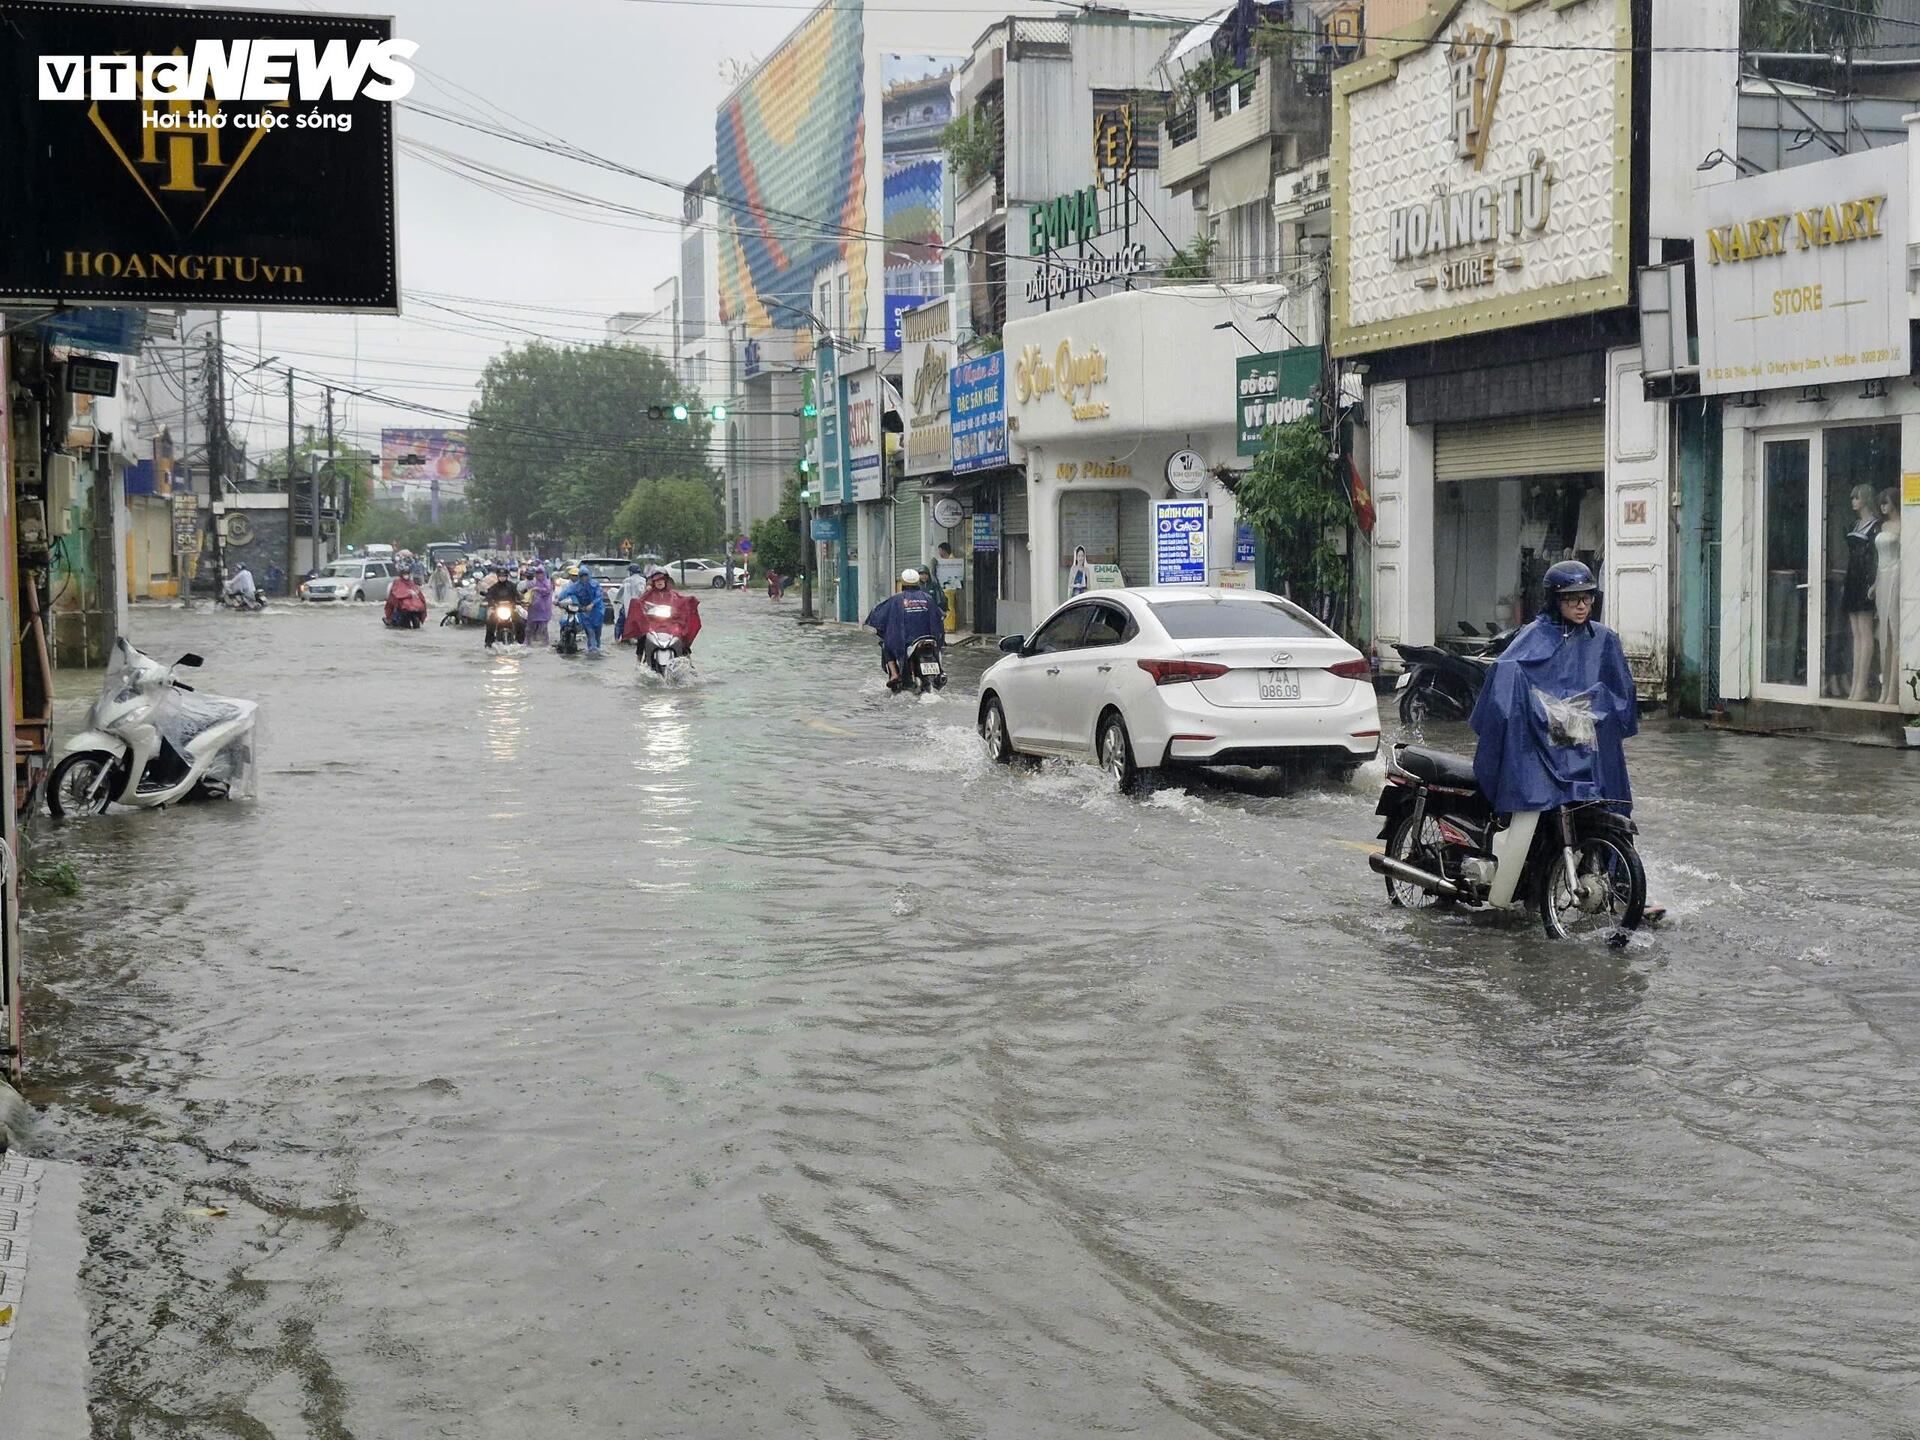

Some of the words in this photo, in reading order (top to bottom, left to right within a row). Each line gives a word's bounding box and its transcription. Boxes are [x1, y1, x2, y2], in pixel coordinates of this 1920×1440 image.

[1029, 184, 1101, 257] EMMA
[1388, 183, 1498, 263] HOÀNG
[1500, 147, 1557, 236] TỬ
[1706, 214, 1791, 266] NARY
[1794, 193, 1888, 250] NARY
[1439, 257, 1495, 291] STORE
[1772, 284, 1824, 317] STORE
[1625, 501, 1646, 524] 154
[1094, 564, 1120, 574] EMMA
[1261, 685, 1299, 698] 086.09
[1267, 670, 1290, 684] 74A
